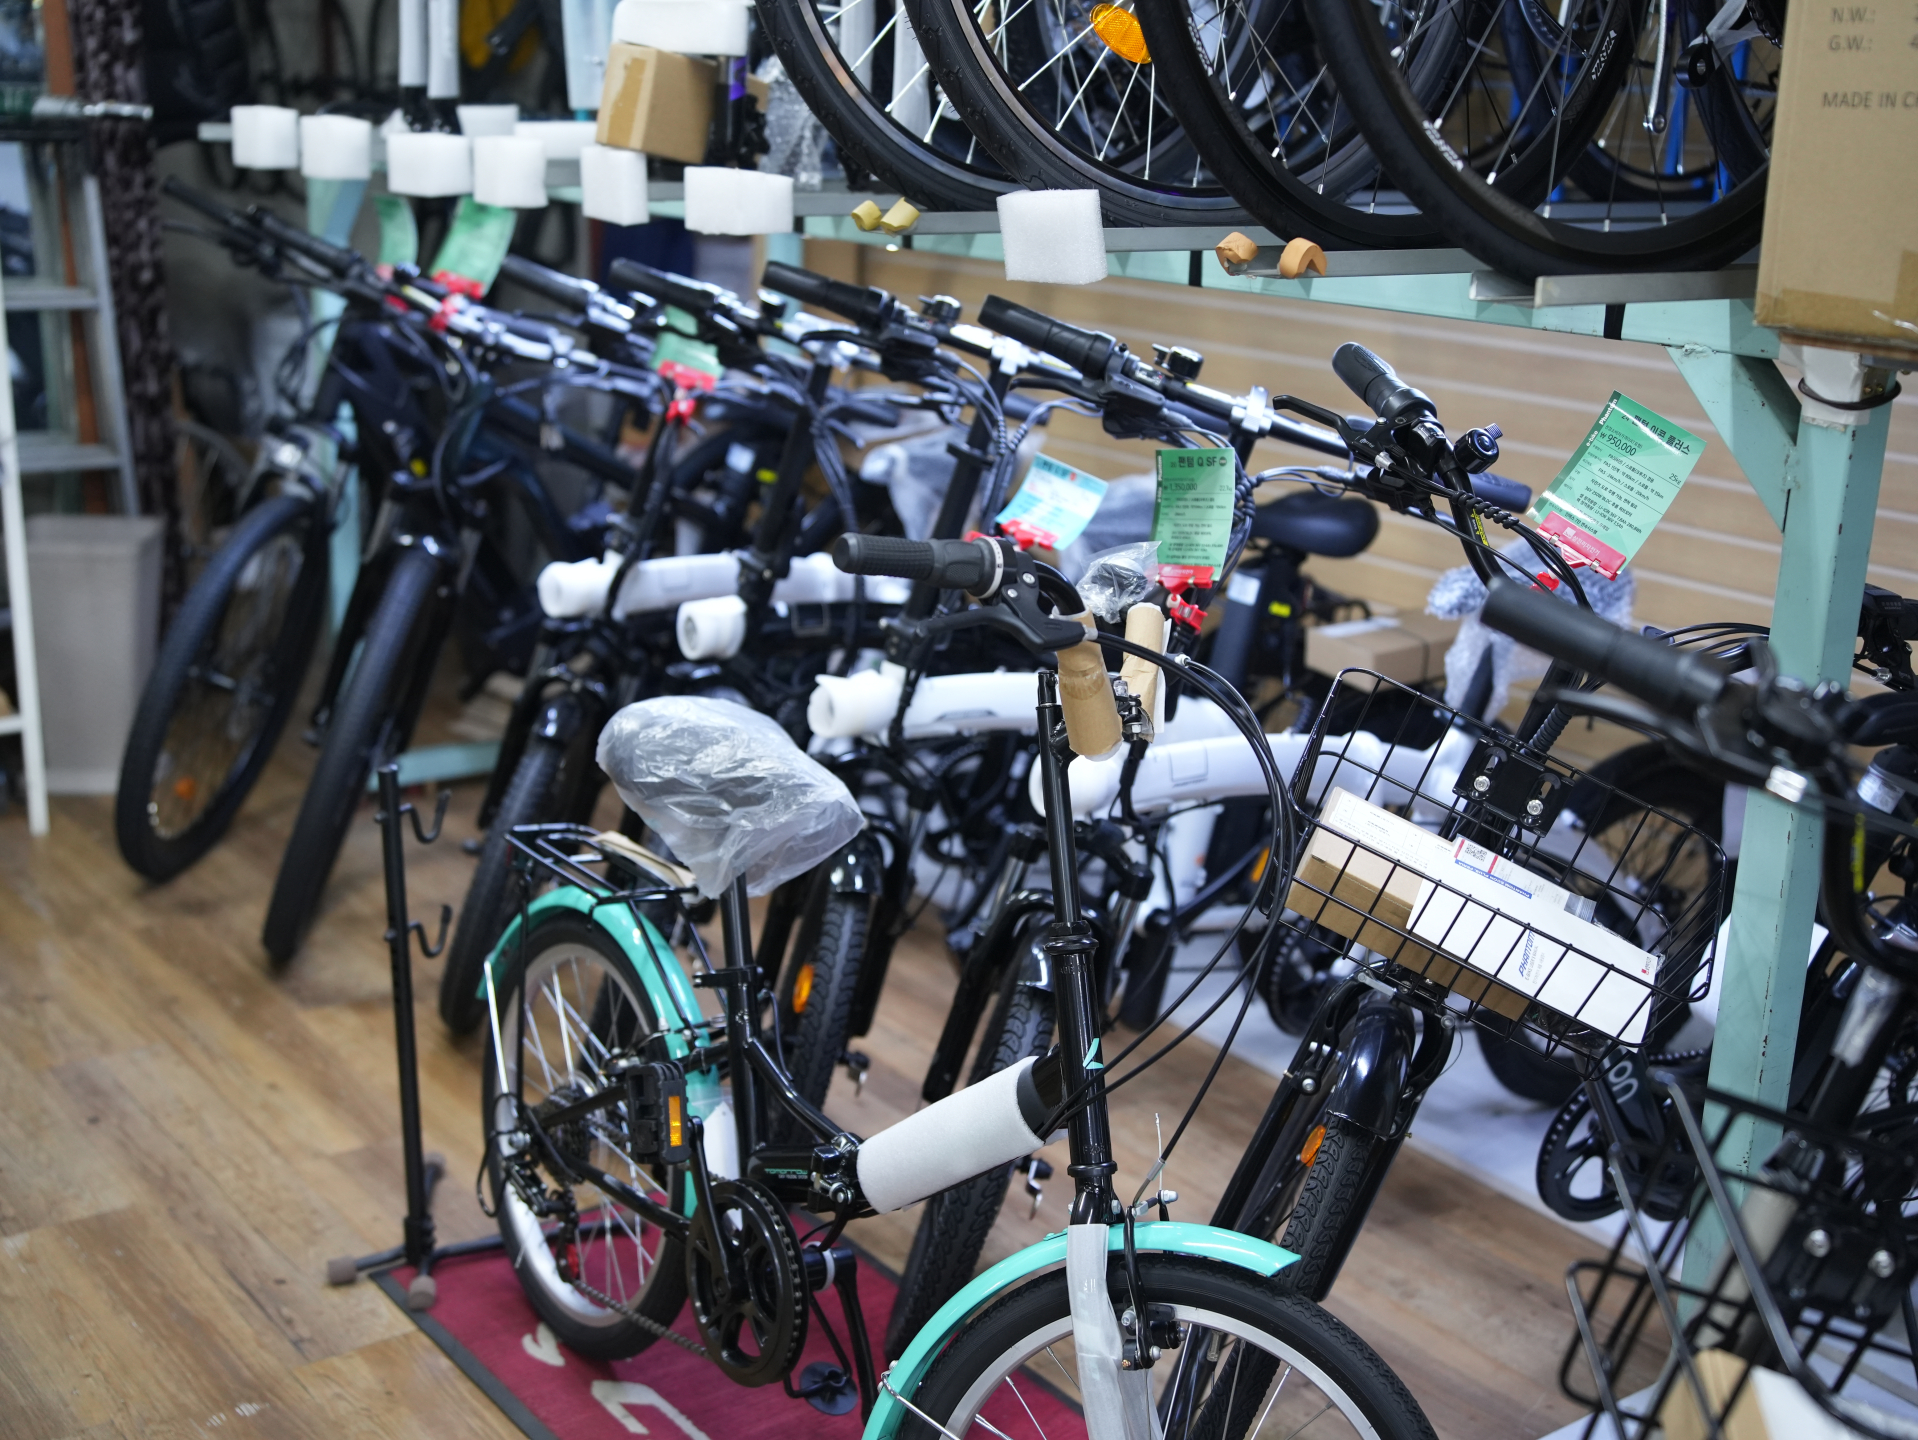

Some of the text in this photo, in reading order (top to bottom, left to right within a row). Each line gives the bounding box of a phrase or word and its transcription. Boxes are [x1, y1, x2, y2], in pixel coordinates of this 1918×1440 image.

[1822, 91, 1872, 109] MADE
[1879, 92, 1897, 108] IN
[1599, 397, 1617, 425] Phantom
[1606, 434, 1636, 456] 950,000
[1665, 435, 1691, 455] 플러스
[1178, 455, 1194, 467] 팬텀
[1197, 456, 1204, 467] Q
[1206, 456, 1217, 466] SF
[1518, 929, 1535, 977] PHANTOM
